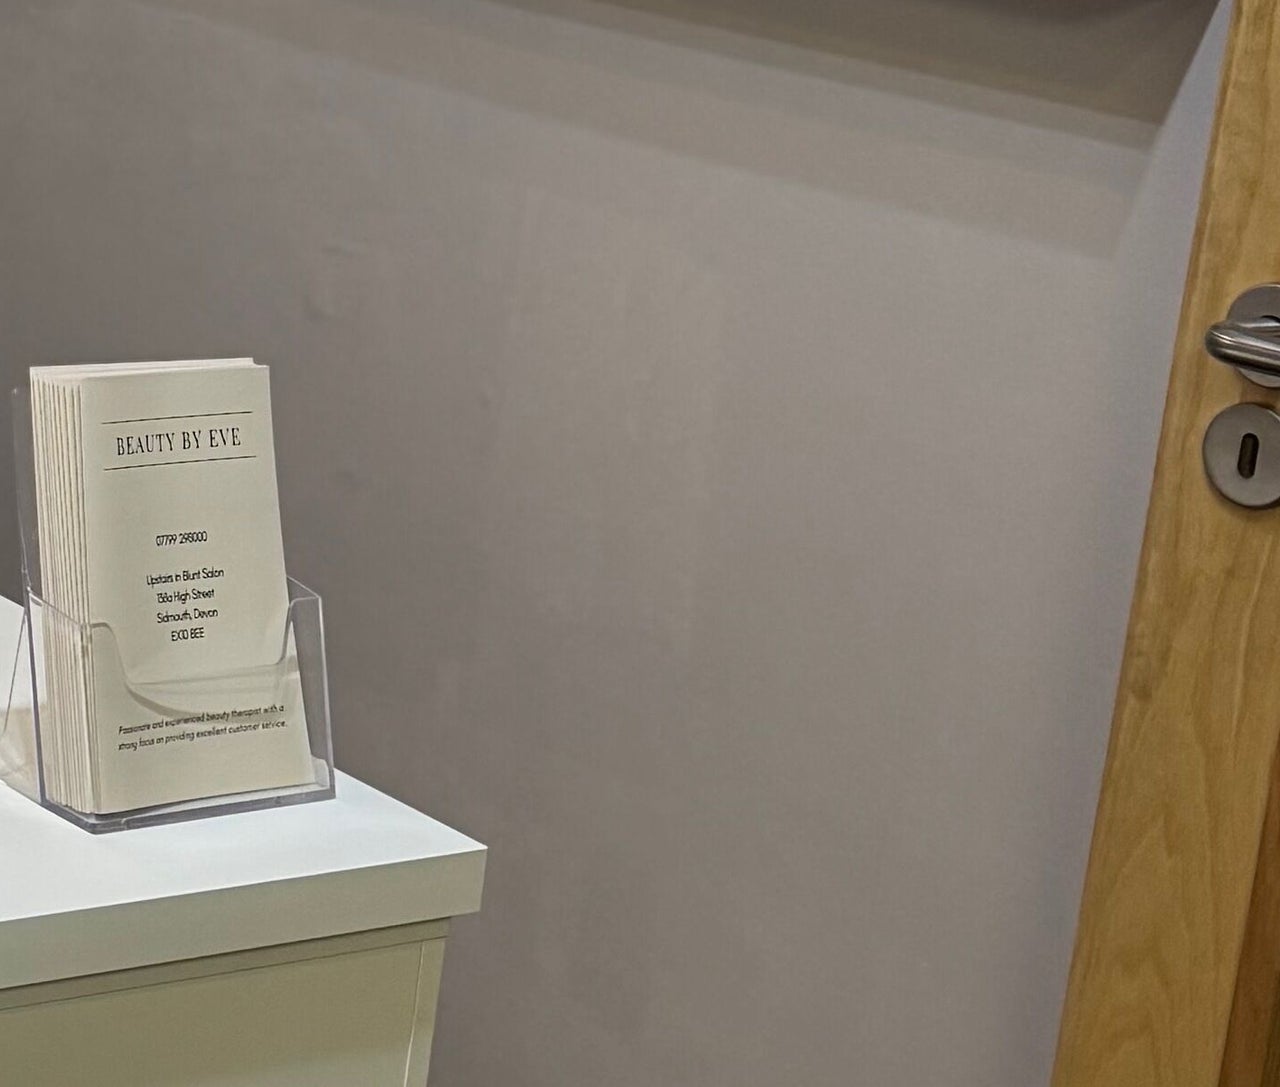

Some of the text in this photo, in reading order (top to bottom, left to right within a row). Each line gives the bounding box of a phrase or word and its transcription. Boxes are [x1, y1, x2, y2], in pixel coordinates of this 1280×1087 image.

[116, 427, 241, 456] BEAUTY BY EVE
[202, 566, 224, 579] Salon
[174, 588, 191, 604] High
[192, 588, 214, 600] Street
[194, 608, 218, 619] Devon
